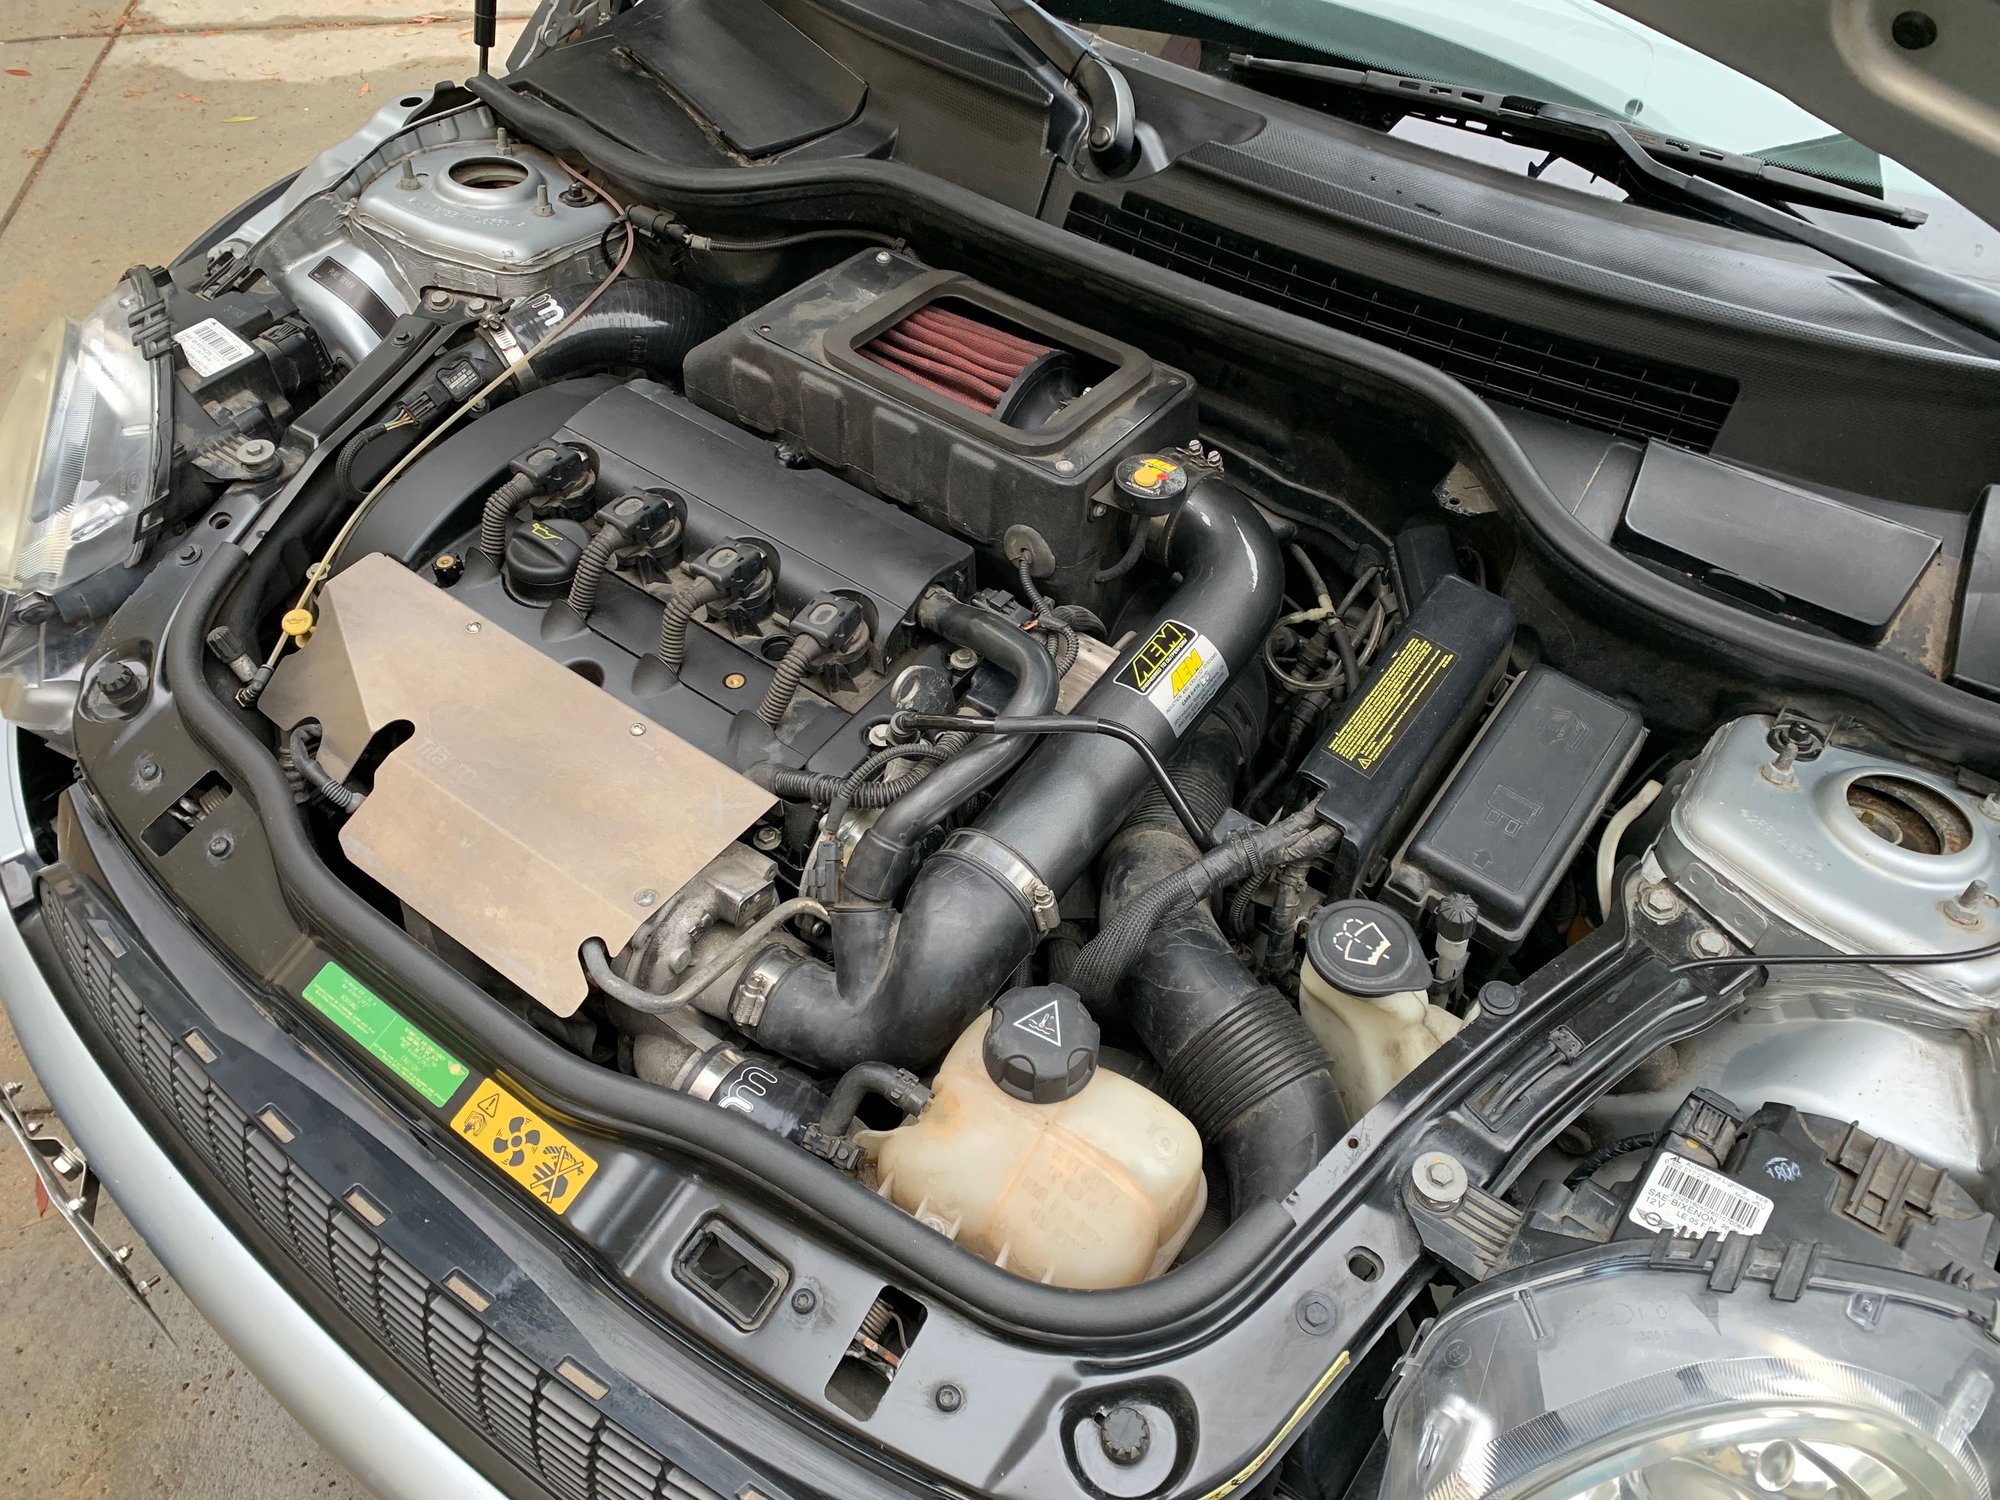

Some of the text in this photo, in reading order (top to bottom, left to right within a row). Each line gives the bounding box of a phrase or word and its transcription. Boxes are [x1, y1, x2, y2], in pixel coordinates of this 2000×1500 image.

[1132, 623, 1185, 688] AEM
[1170, 648, 1204, 698] AEM
[1685, 1161, 1721, 1181] Automotive
[1721, 1178, 1748, 1194] Lighting
[1647, 1187, 1717, 1225] SAE-BIXENON
